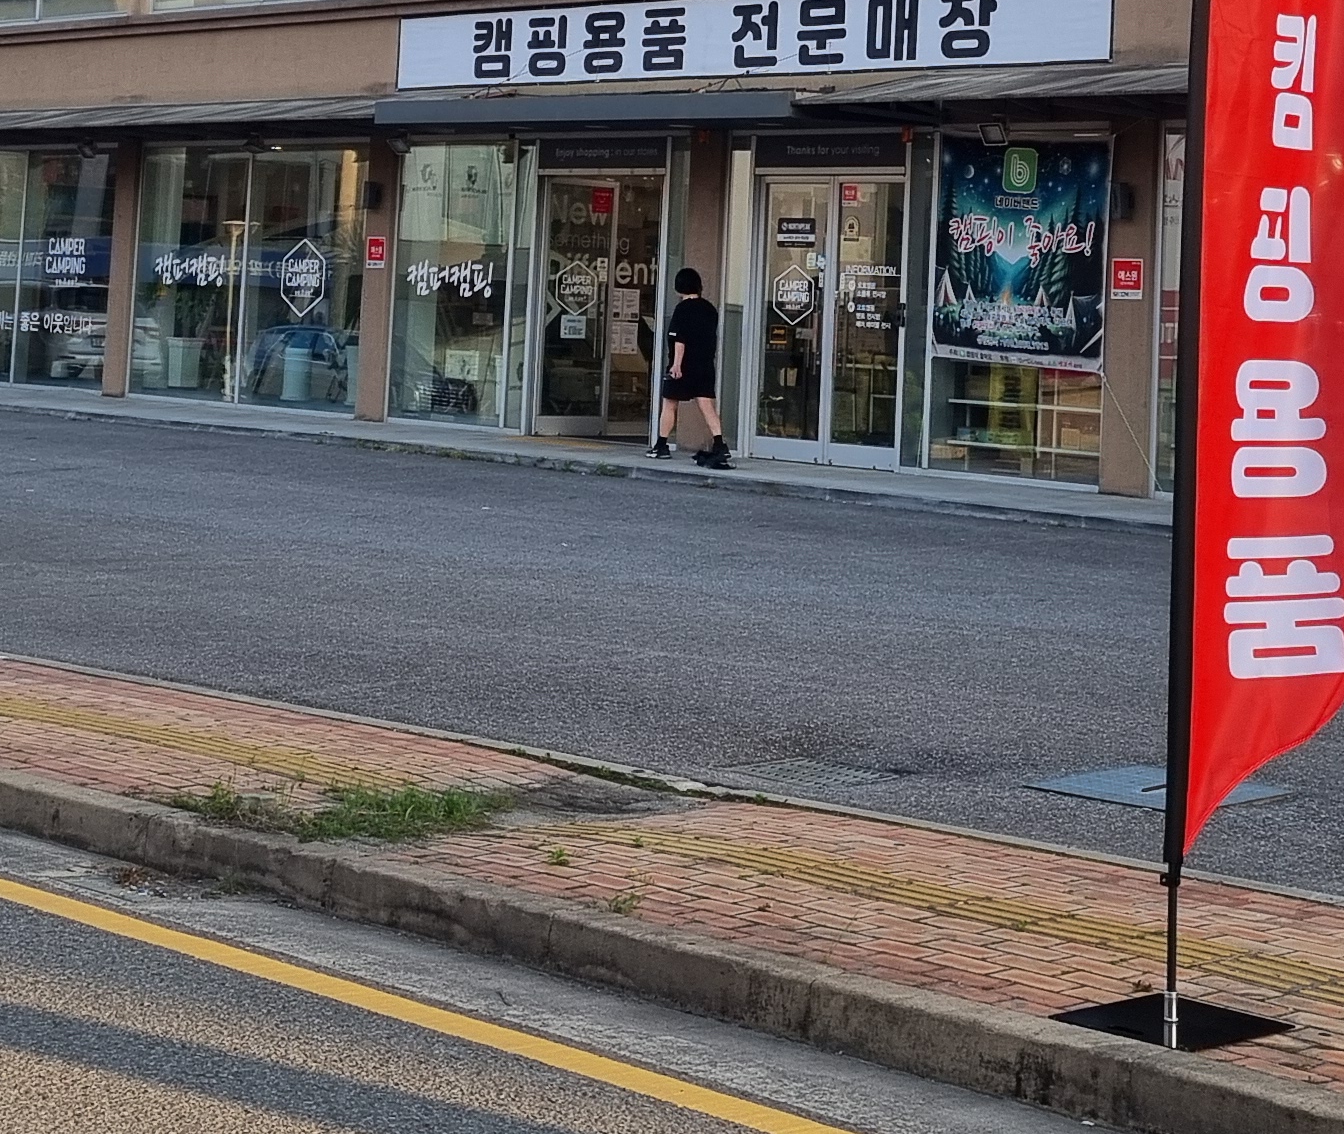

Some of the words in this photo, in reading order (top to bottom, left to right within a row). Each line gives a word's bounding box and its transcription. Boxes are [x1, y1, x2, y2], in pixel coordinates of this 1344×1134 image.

[473, 6, 687, 80] 캠핑용품
[786, 145, 816, 156] Thanks
[817, 144, 830, 155] for
[831, 146, 849, 157] your
[994, 195, 1040, 211] 네이버밴드
[48, 237, 86, 256] CAMPER
[948, 213, 1015, 256] 캠핑이
[1023, 215, 1096, 267] 좋아요!
[45, 257, 86, 275] CAMPING
[154, 252, 226, 287] 캠퍼캠핑
[288, 258, 320, 274] CAMPER
[285, 272, 321, 288] CAMPING
[406, 259, 494, 298] 캠퍼캠핑
[562, 273, 593, 285] CAMPER
[778, 279, 809, 292] CAMPER
[560, 284, 594, 296] CAMPING
[777, 291, 811, 303] CAMPING
[20, 311, 41, 332] 좋은
[43, 312, 93, 334] 이웃입니다
